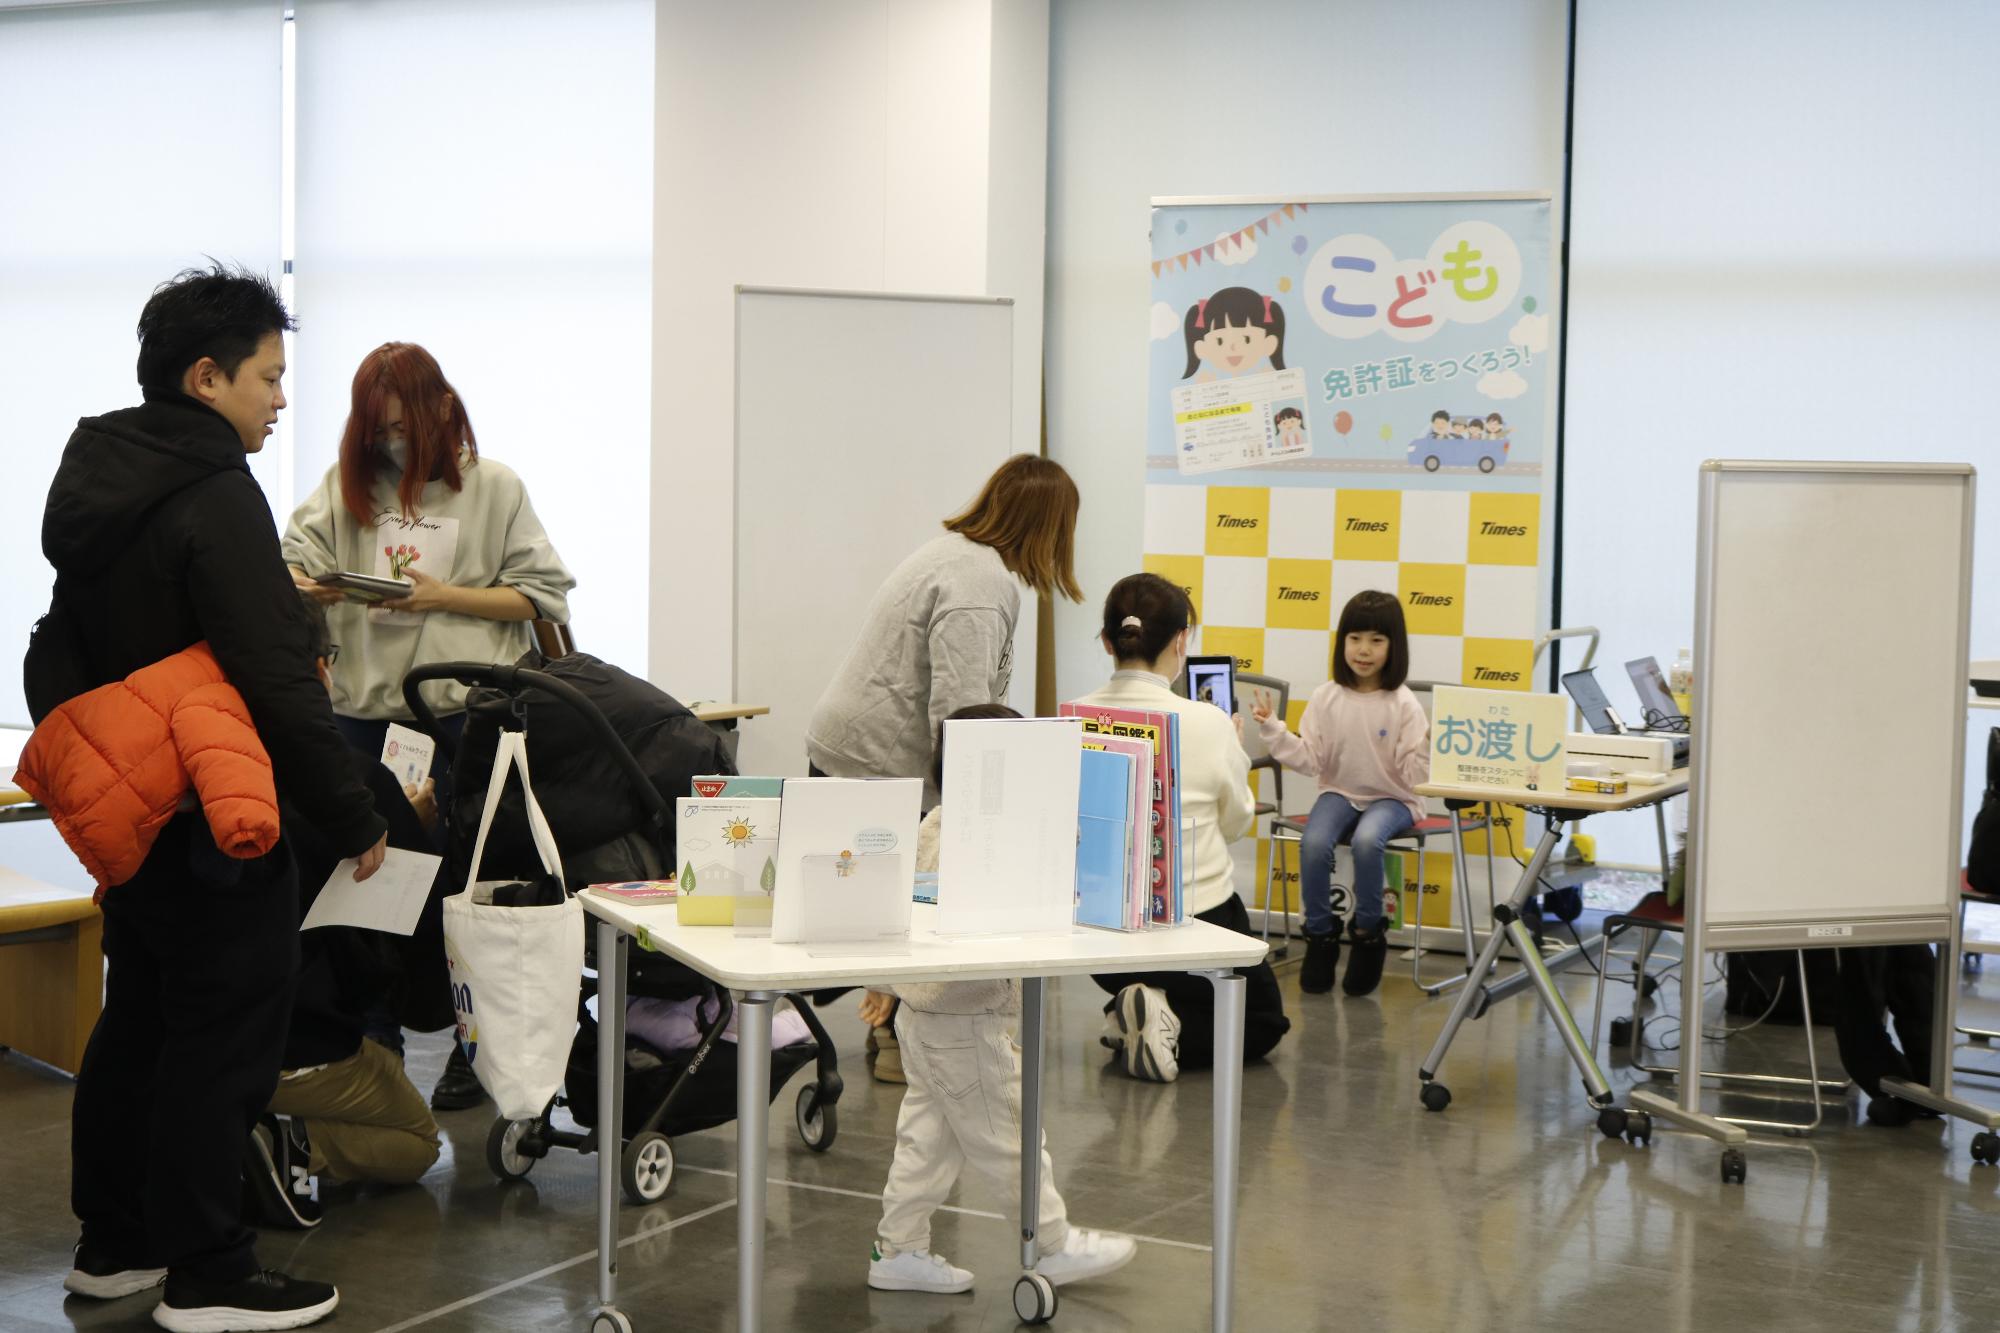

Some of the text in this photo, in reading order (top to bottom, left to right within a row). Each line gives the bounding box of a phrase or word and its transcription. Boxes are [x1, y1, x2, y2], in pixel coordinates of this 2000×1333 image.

[1322, 240, 1498, 328] こども
[1323, 345, 1531, 400] 免許証をつくろう!
[1216, 514, 1258, 529] Times
[1345, 517, 1389, 532] Times
[1480, 521, 1527, 536] Times
[1277, 586, 1320, 601] Times
[1408, 591, 1453, 606] Times
[1473, 666, 1520, 682] Times
[1436, 714, 1562, 763] お渡し
